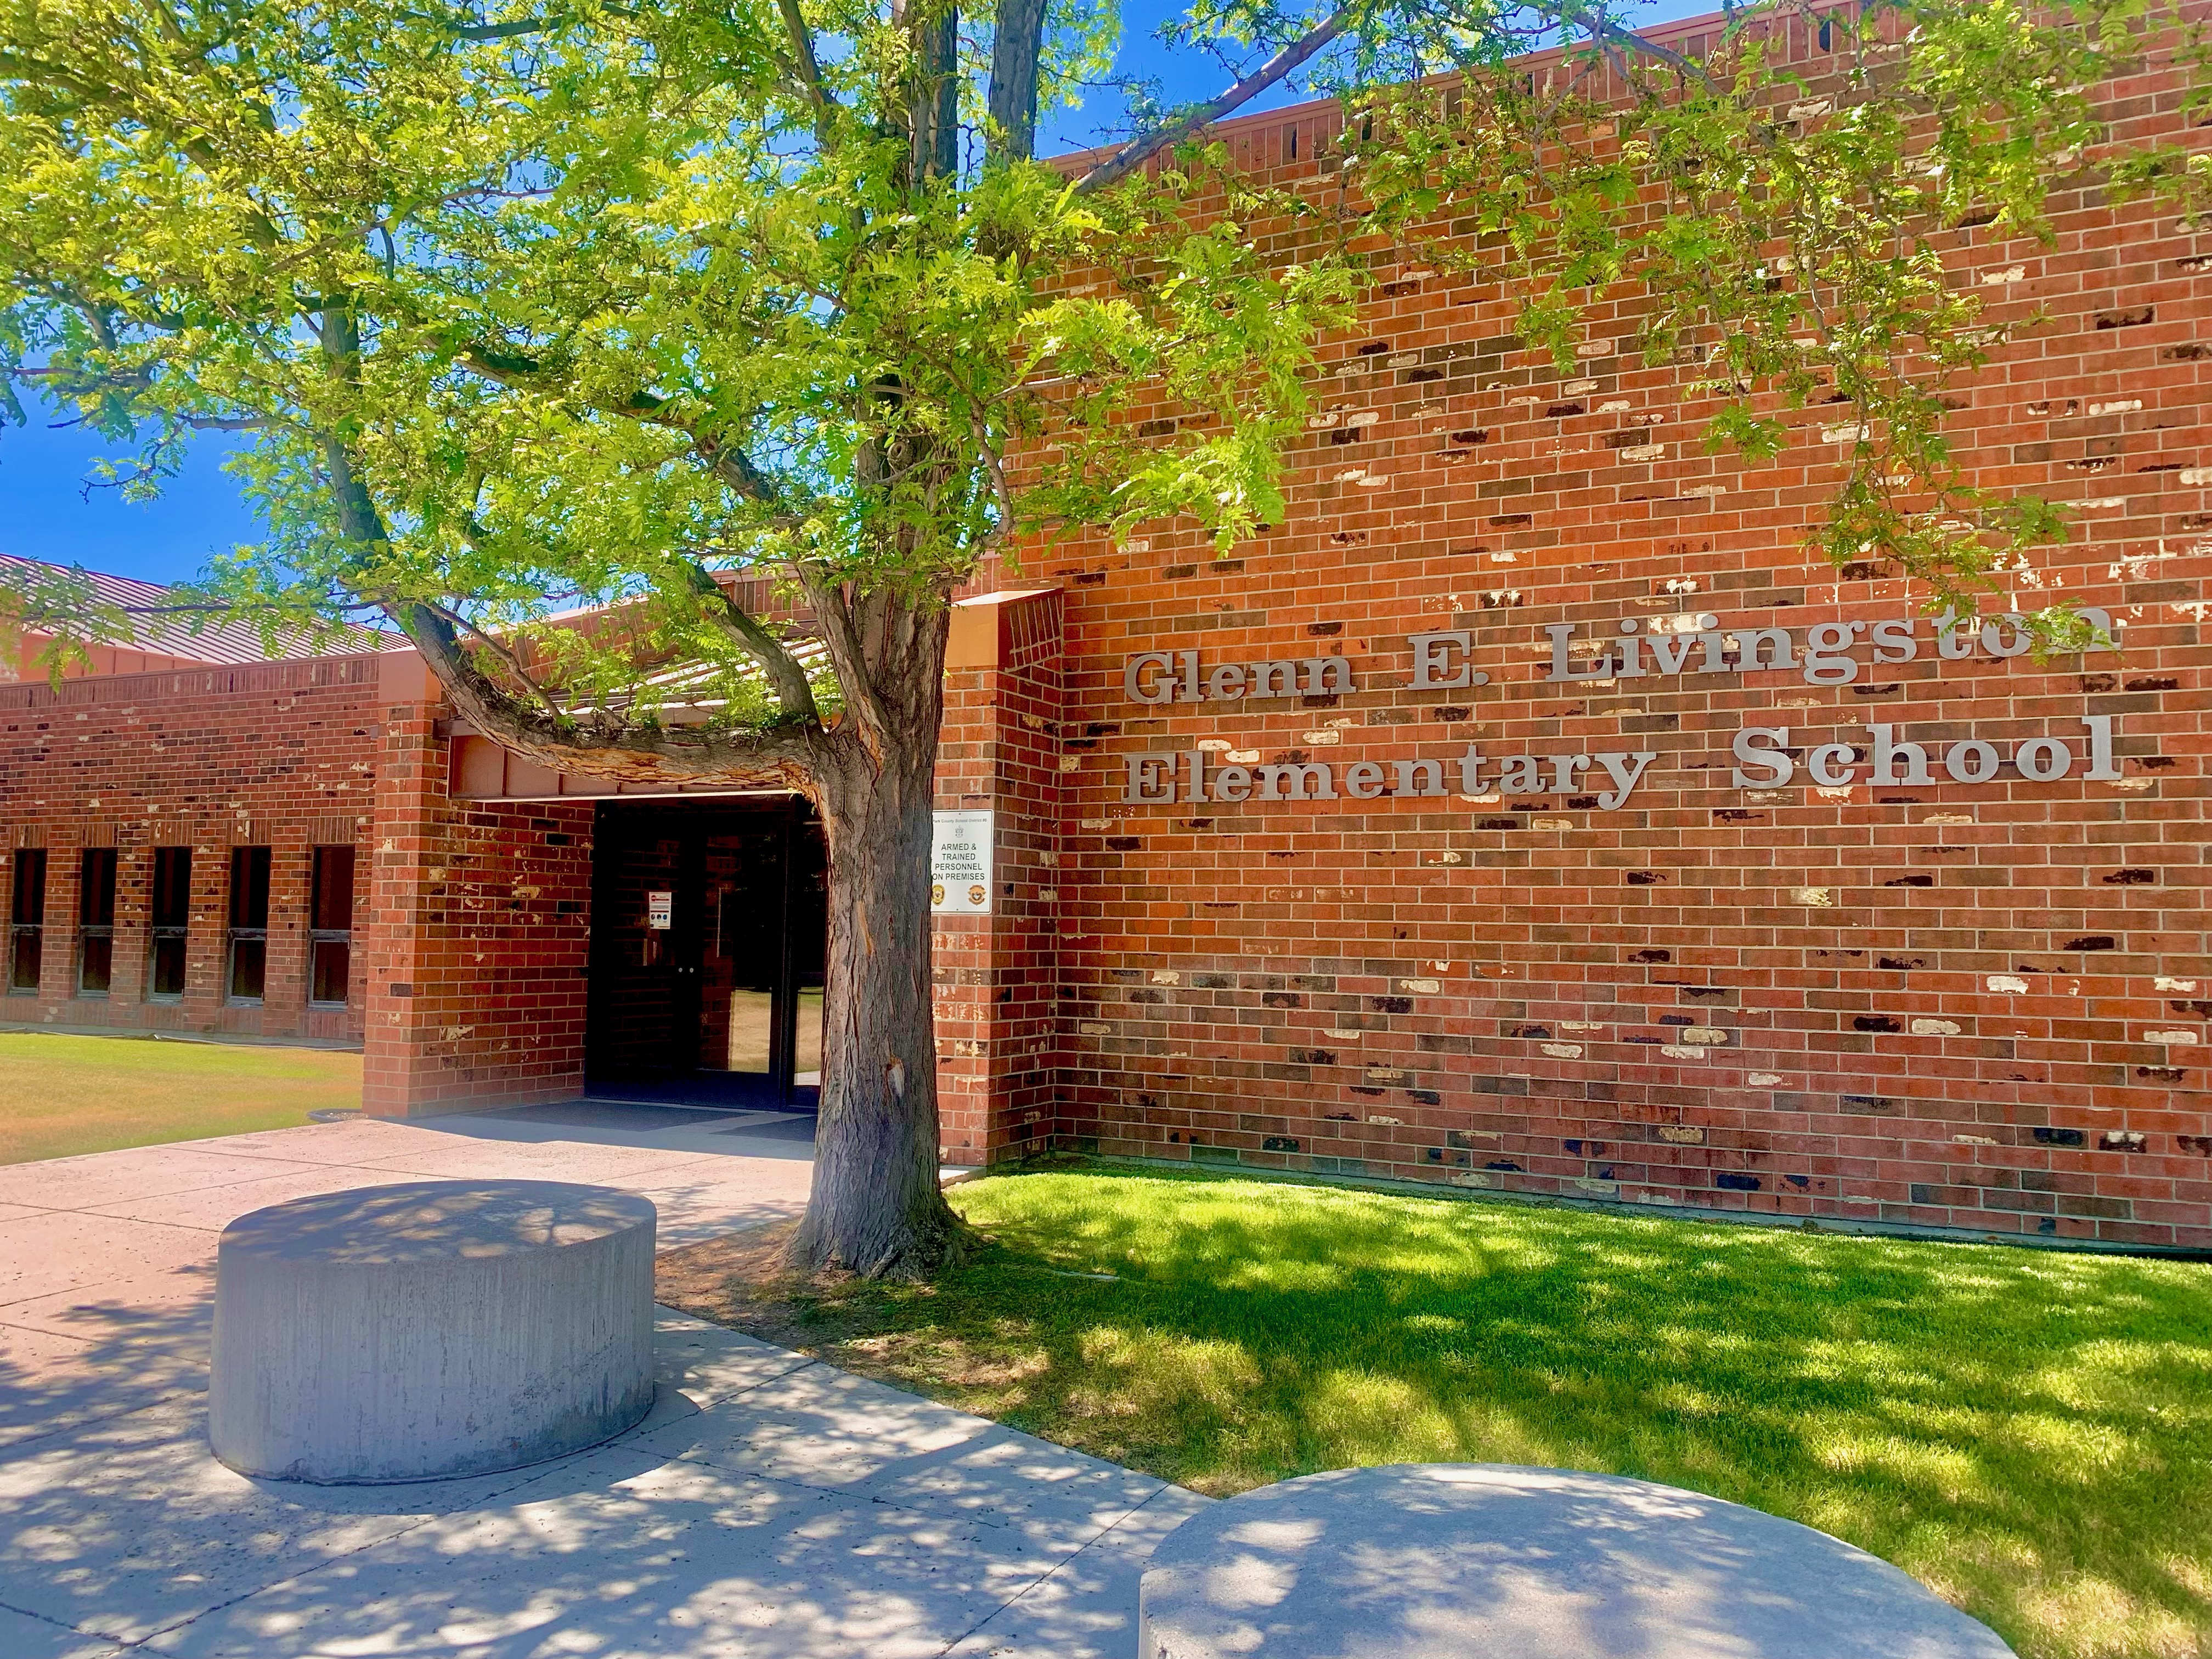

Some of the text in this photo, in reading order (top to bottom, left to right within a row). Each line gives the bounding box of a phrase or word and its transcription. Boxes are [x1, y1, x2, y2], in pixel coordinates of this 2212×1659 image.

[1124, 603, 2122, 706] Glenn E. Livingston
[1121, 715, 2124, 811] Elementary School
